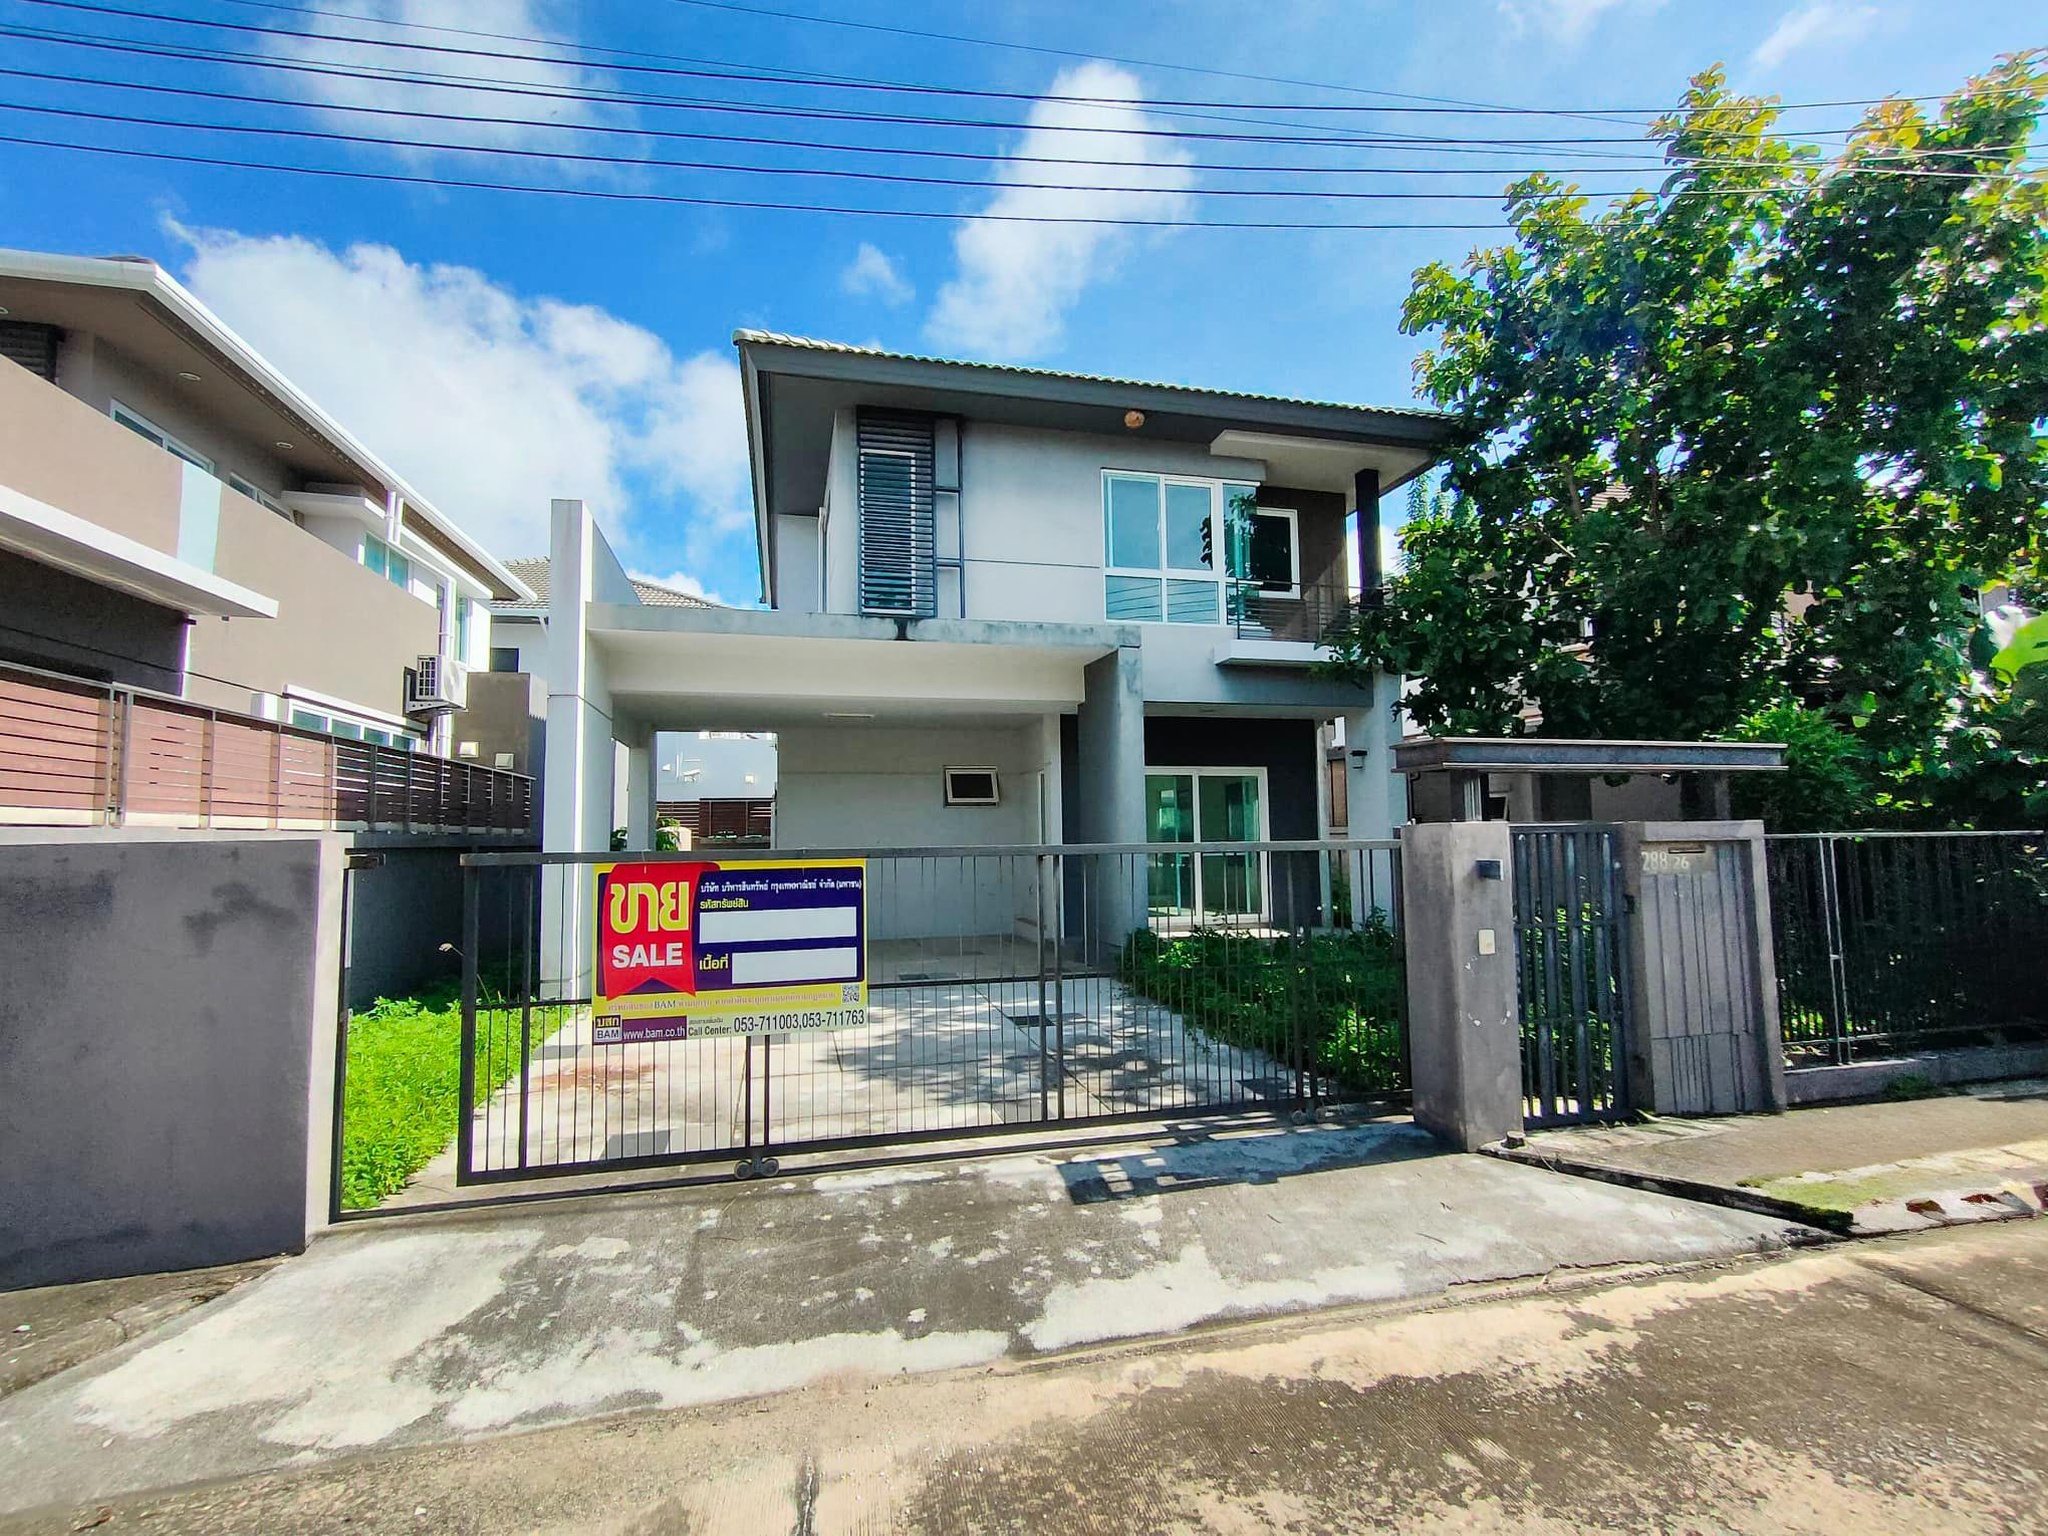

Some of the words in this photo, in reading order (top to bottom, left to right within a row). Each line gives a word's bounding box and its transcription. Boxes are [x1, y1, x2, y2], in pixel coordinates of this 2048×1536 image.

[1641, 851, 1667, 871] 288
[610, 881, 690, 934] ขาย
[700, 898, 748, 909] รหัสทรัพย์สิน
[612, 942, 683, 968] SALE
[699, 953, 729, 970] เนื้อที่
[654, 1000, 676, 1009] BAM
[734, 1009, 865, 1033] 053-711003,053-711763
[597, 1029, 619, 1039] BAM
[623, 1026, 686, 1040] www.bam.co.th
[688, 1026, 703, 1036] Call
[704, 1025, 732, 1035] Center:
